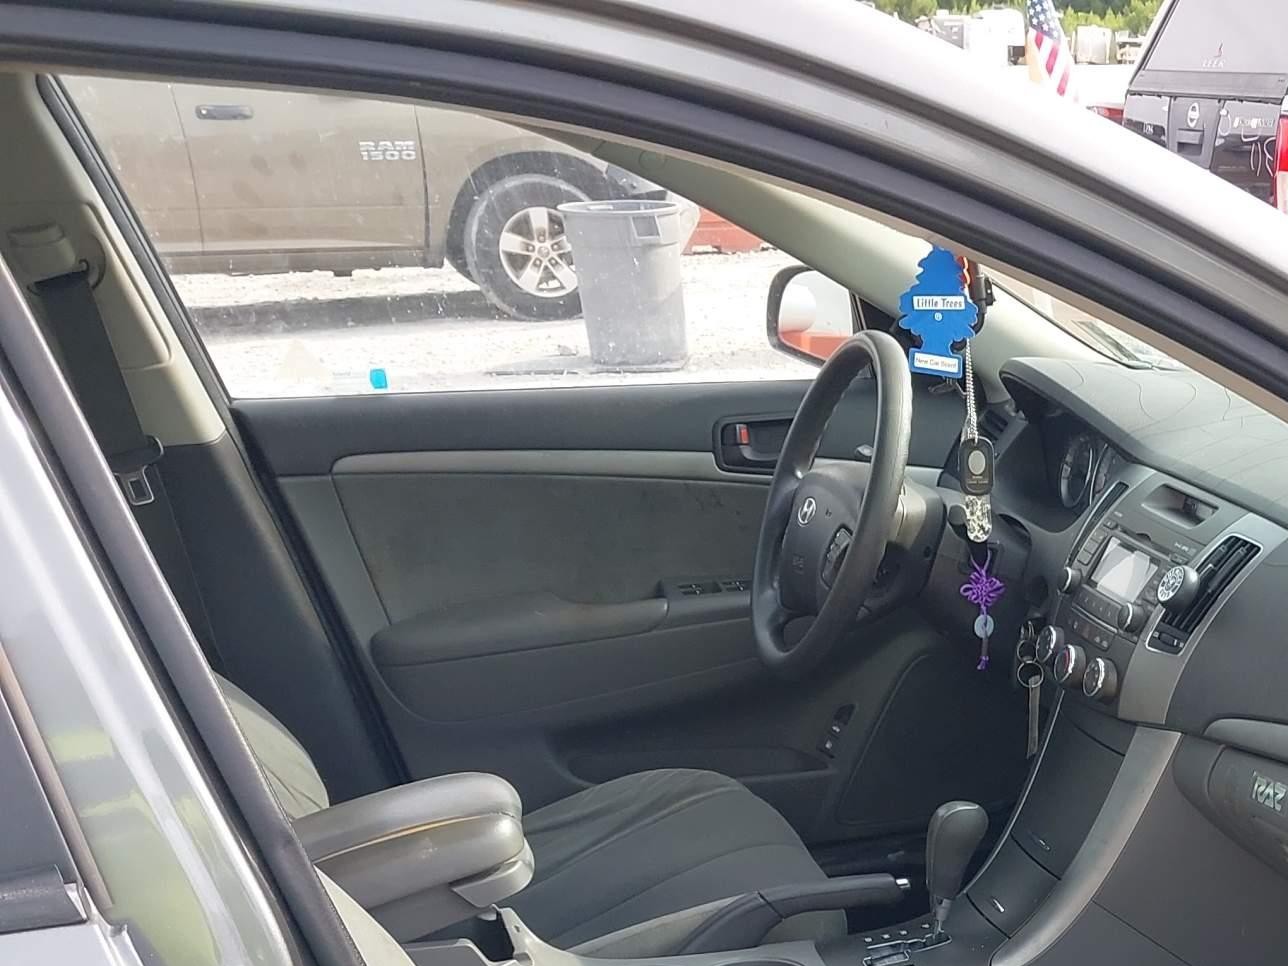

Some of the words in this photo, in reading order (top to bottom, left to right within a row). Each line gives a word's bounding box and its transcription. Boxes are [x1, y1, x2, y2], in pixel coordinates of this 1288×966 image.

[358, 141, 415, 150] RAM
[361, 150, 416, 160] 1500
[917, 298, 939, 308] Little
[941, 298, 963, 308] Trees
